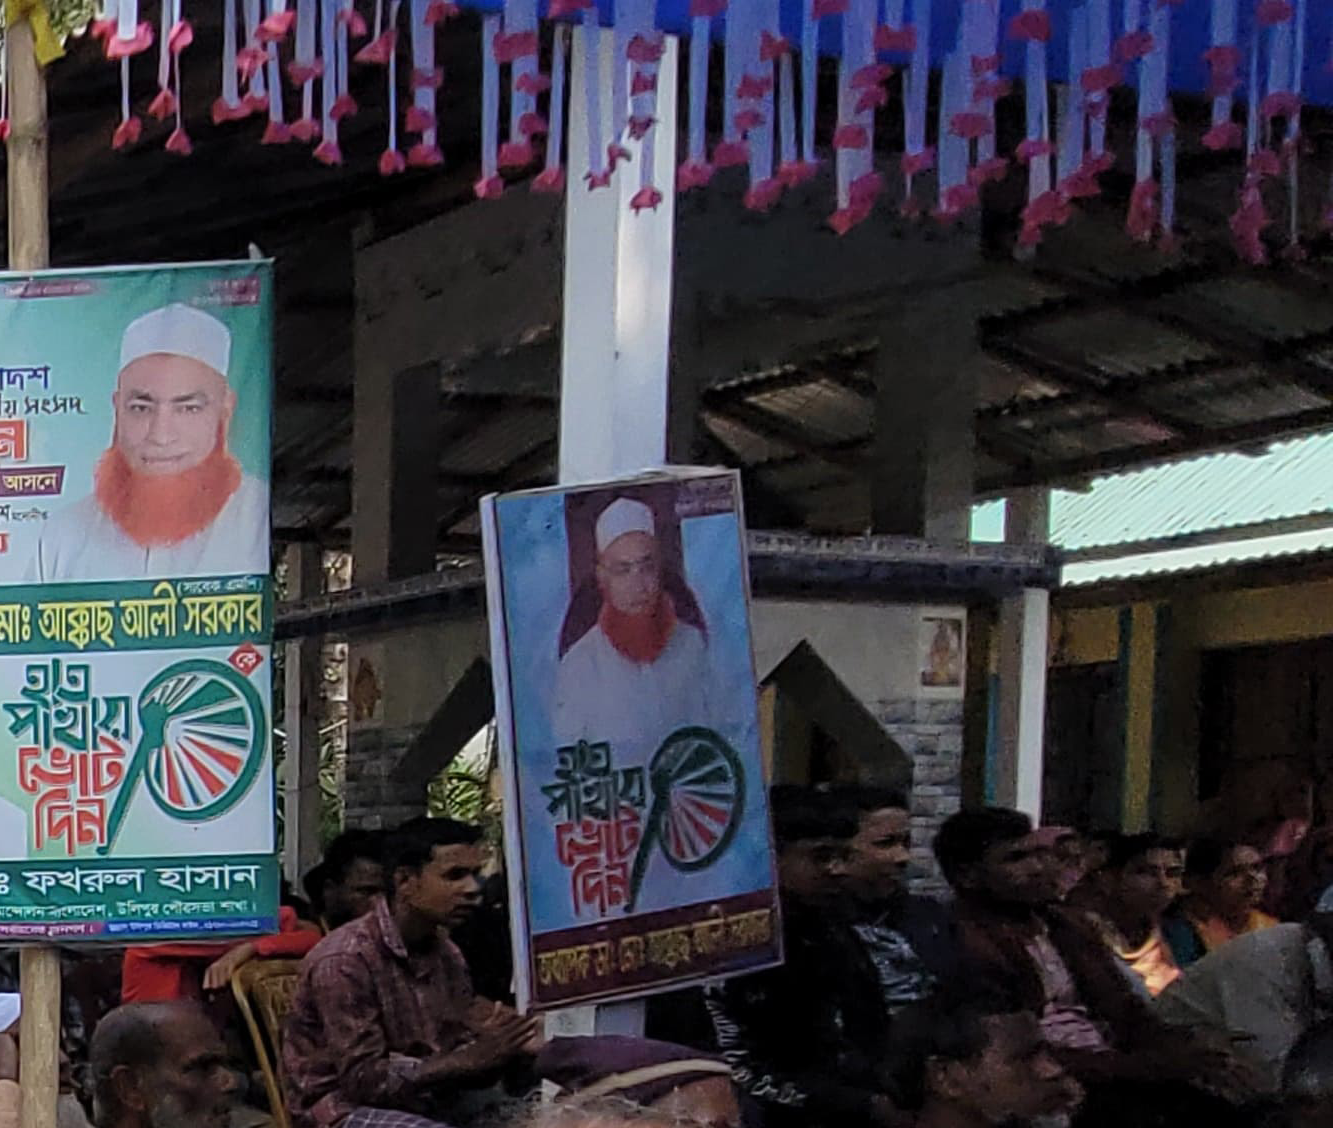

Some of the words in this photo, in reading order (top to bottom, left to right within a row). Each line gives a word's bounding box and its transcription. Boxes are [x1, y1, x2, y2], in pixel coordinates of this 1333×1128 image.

[23, 396, 86, 415] সংসদ
[2, 471, 58, 493] আসনে
[120, 581, 178, 640] আলী
[181, 593, 263, 636] সরকার
[18, 735, 126, 796] ভোট
[34, 785, 107, 856] দিন
[21, 867, 146, 897] ফখরুল
[154, 864, 261, 893] হাসান
